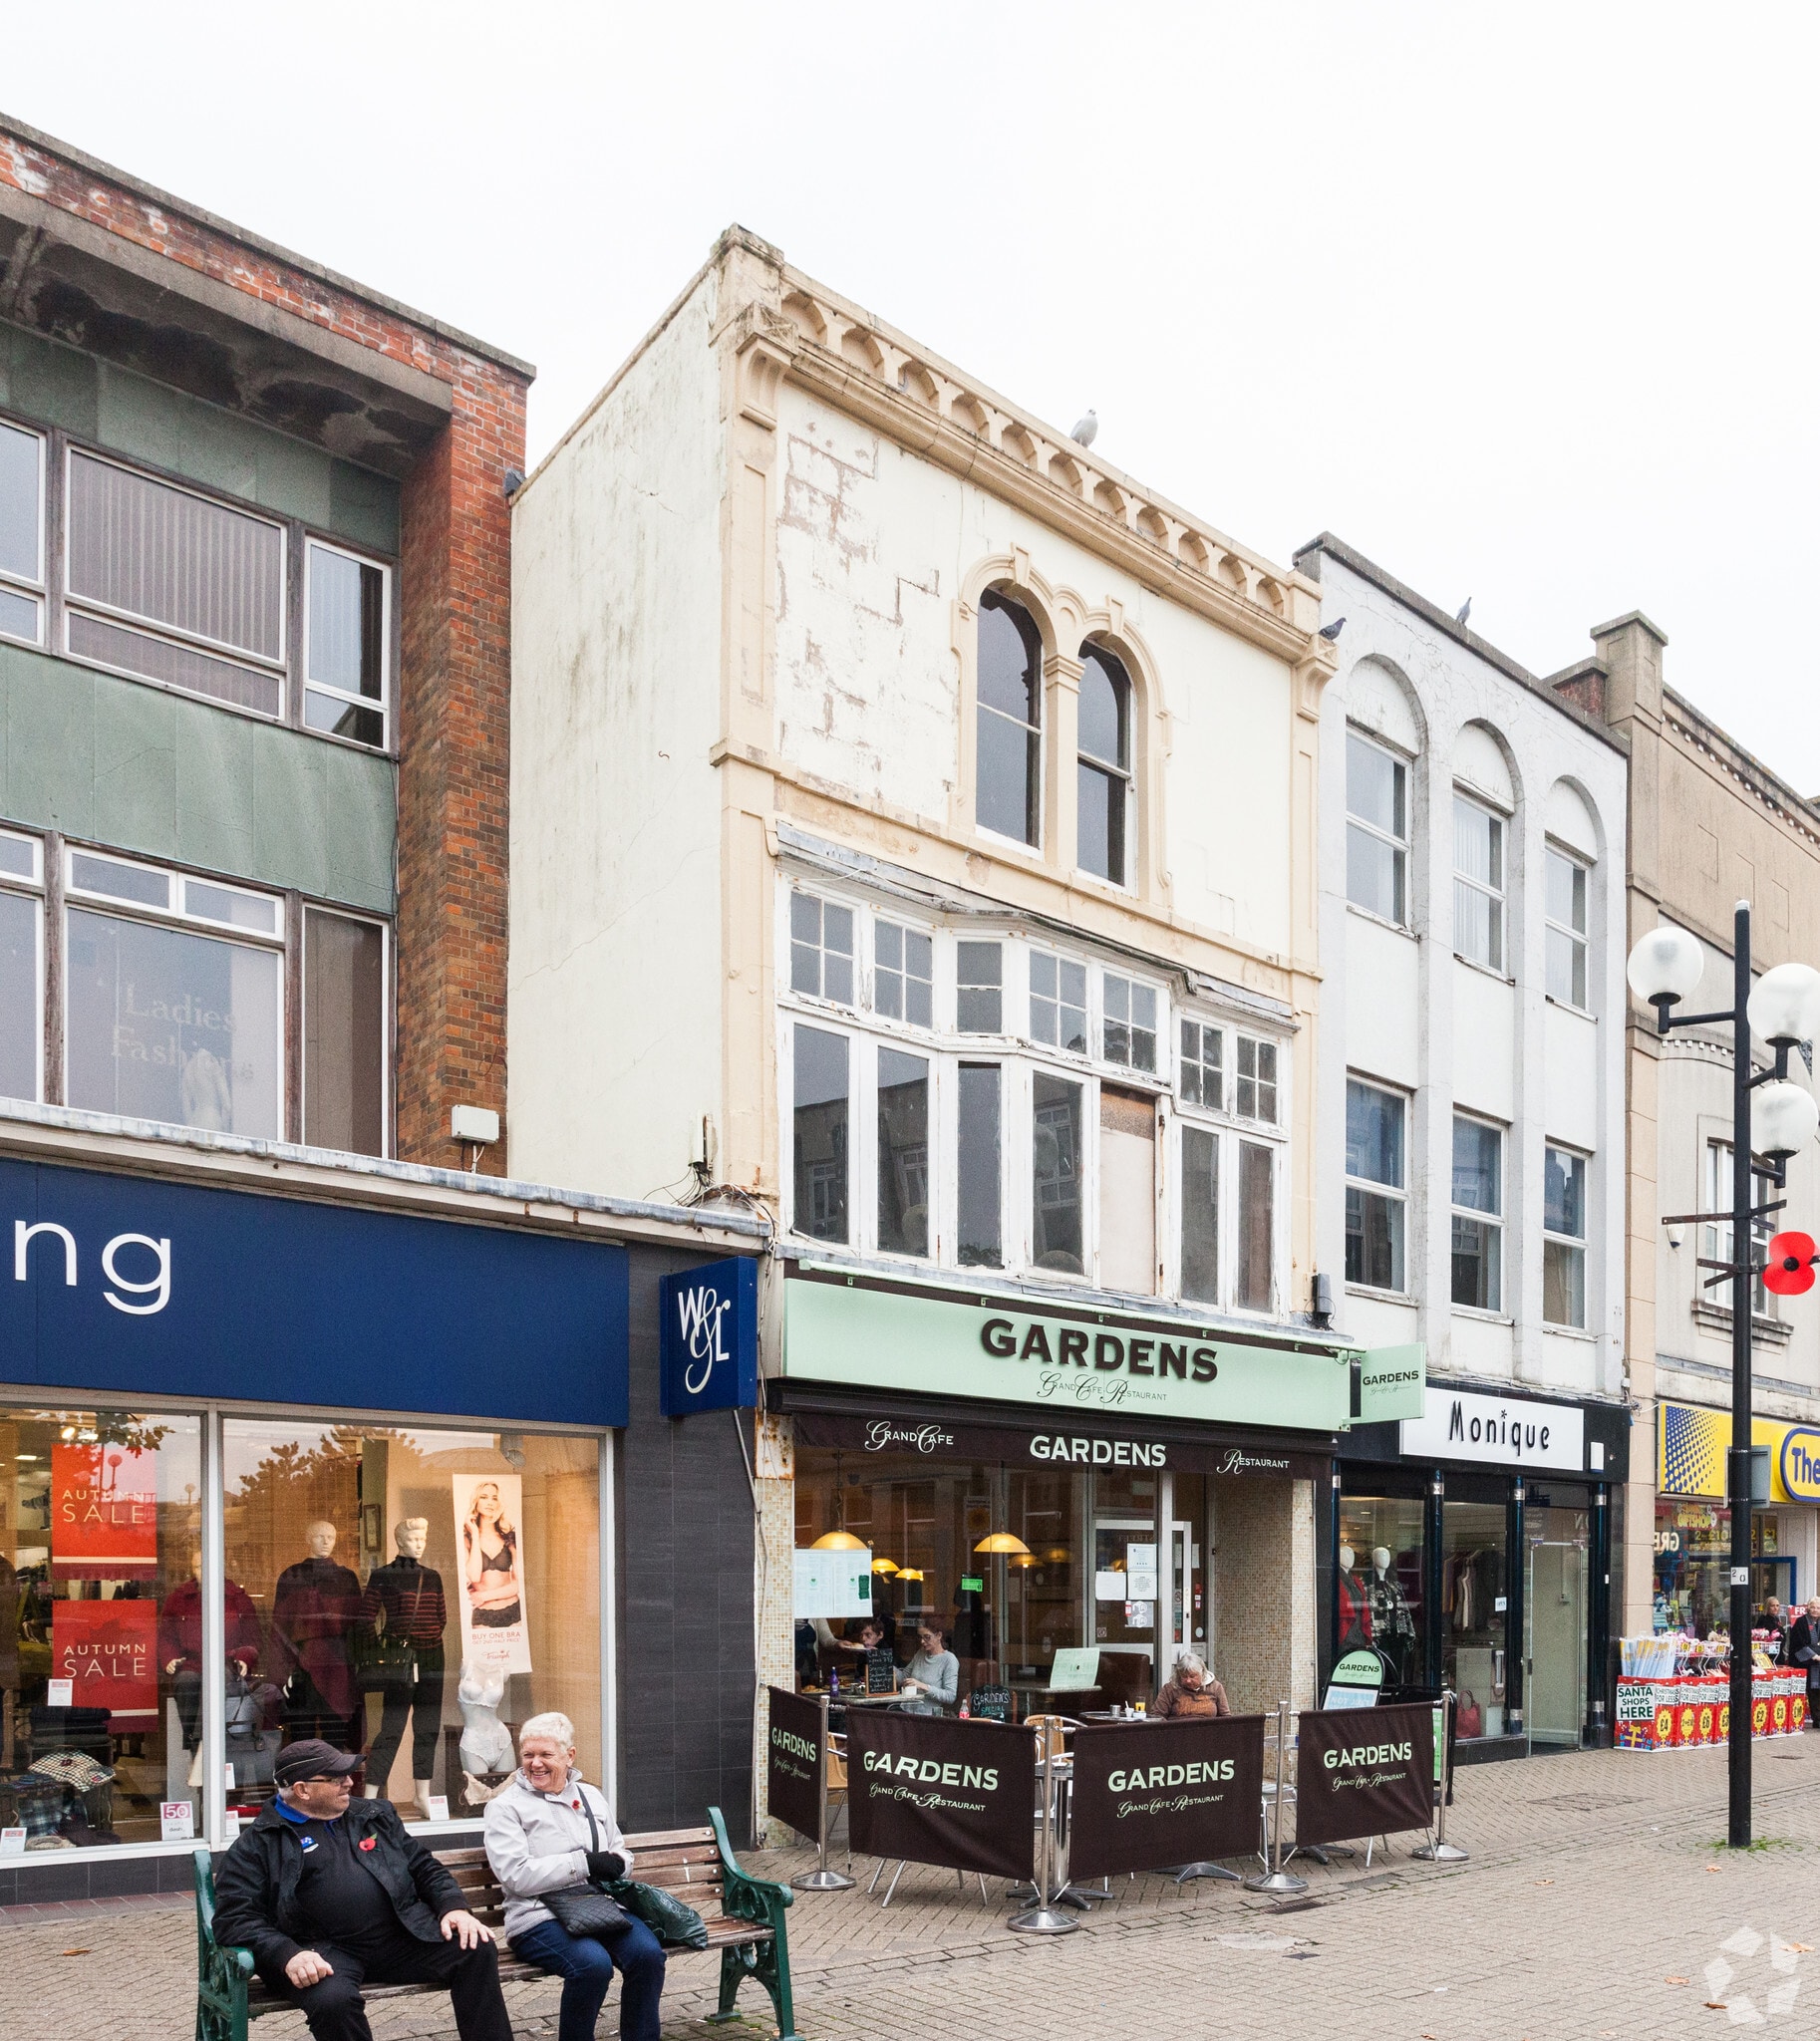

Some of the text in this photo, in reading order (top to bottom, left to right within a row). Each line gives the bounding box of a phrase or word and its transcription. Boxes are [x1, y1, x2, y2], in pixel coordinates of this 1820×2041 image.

[15, 1220, 171, 1315] ng
[980, 1317, 1218, 1382] GARDENS
[1363, 1370, 1419, 1385] GARDENS
[1449, 1400, 1550, 1456] Monique
[1029, 1435, 1166, 1467] GARDENS
[1216, 1448, 1290, 1475] RESTAURANT
[62, 1489, 145, 1501] AUTUMN
[63, 1503, 145, 1524] SALE
[1794, 1606, 1806, 1615] FR
[63, 1643, 147, 1655] AUTUMN
[64, 1657, 147, 1678] SALE
[1339, 1663, 1380, 1673] GARDENS
[1618, 1686, 1654, 1697] SANTA
[1620, 1706, 1654, 1718] HERE
[1660, 1718, 1668, 1732] £4
[771, 1726, 817, 1763] GARDENS
[1324, 1742, 1412, 1769] GARDENS
[863, 1750, 999, 1791] GARDENS
[1107, 1759, 1235, 1792] GARDENS
[165, 1805, 189, 1819] 50
[1170, 1794, 1224, 1812] RESTAURANT
